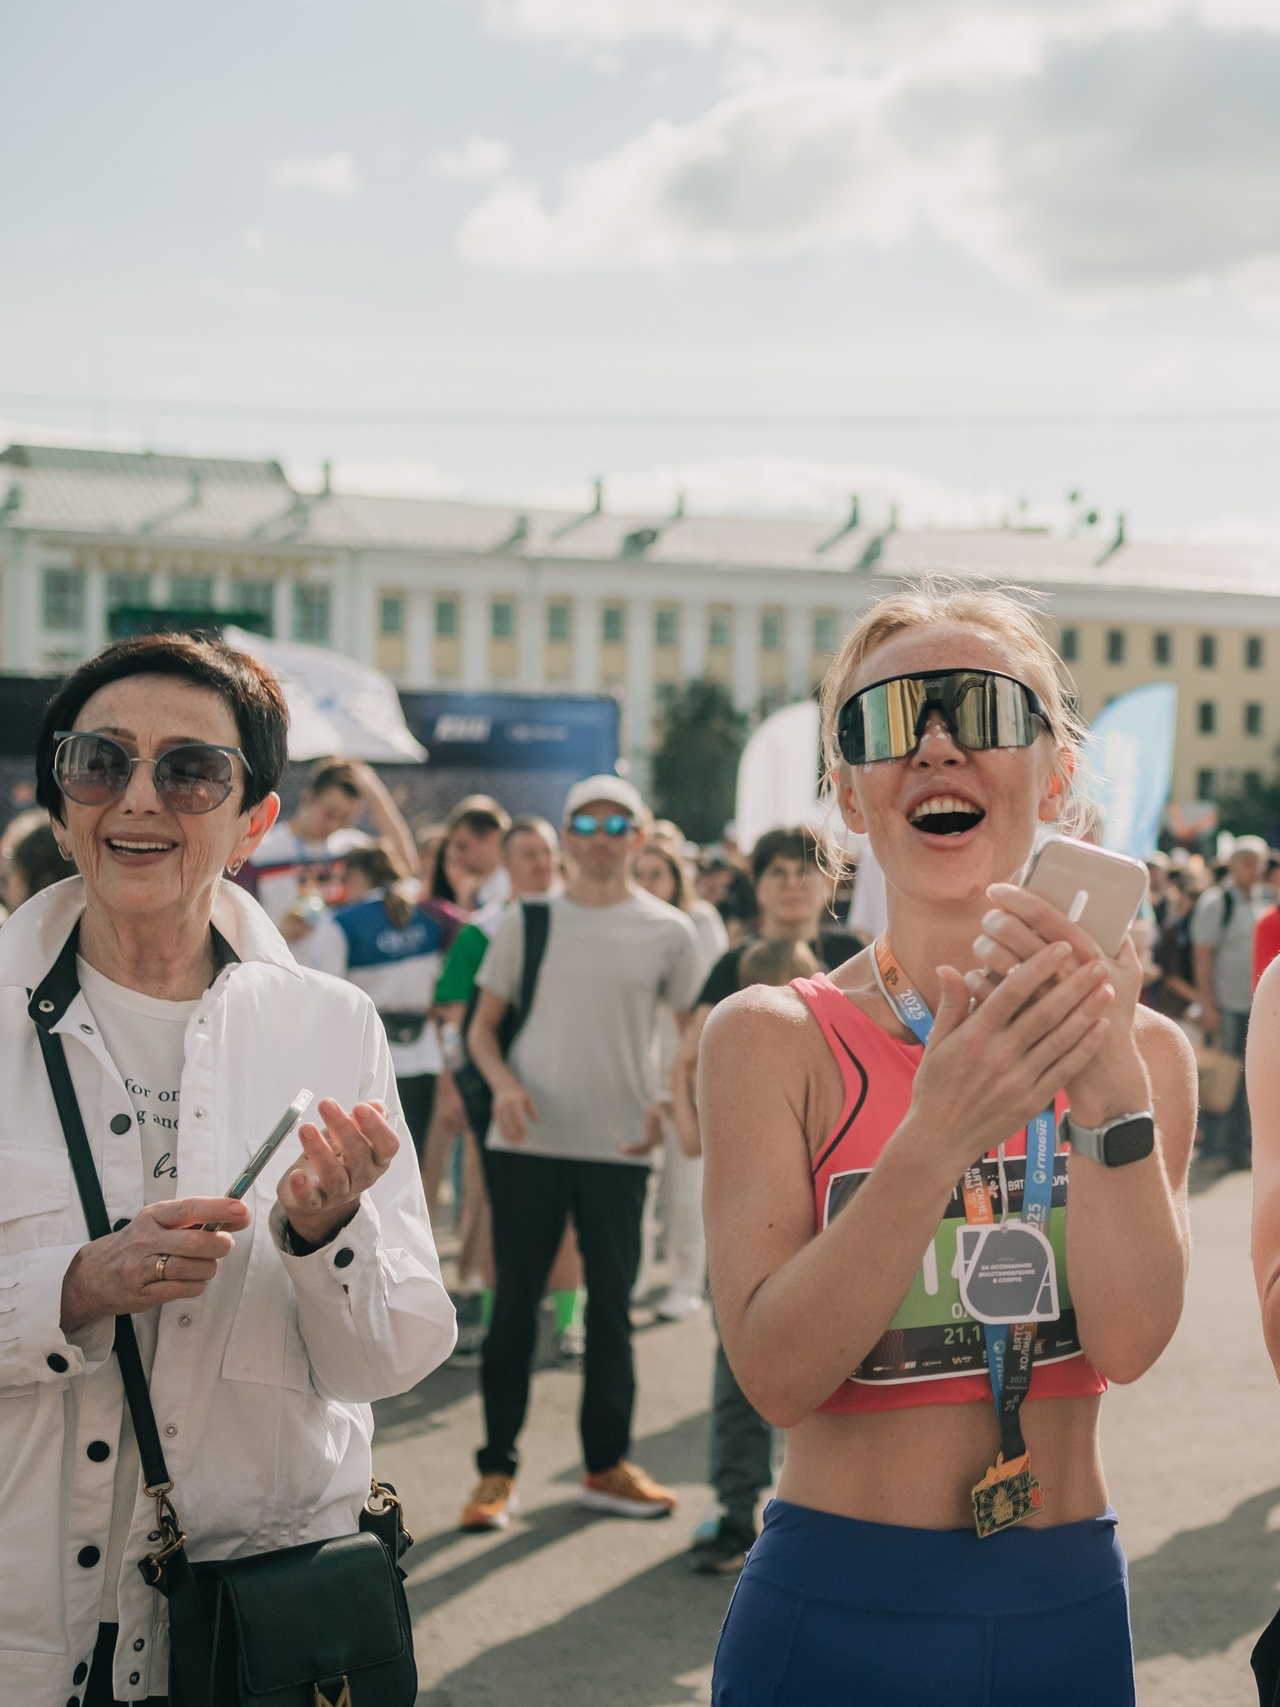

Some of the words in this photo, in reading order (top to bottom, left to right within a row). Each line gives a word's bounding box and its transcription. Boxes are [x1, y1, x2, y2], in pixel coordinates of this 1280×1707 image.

[899, 989, 926, 1020] 2025
[125, 1078, 151, 1098] for
[971, 1167, 988, 1215] ВЯТСКИЕ
[1019, 1331, 1032, 1371] ХОЛМЫ
